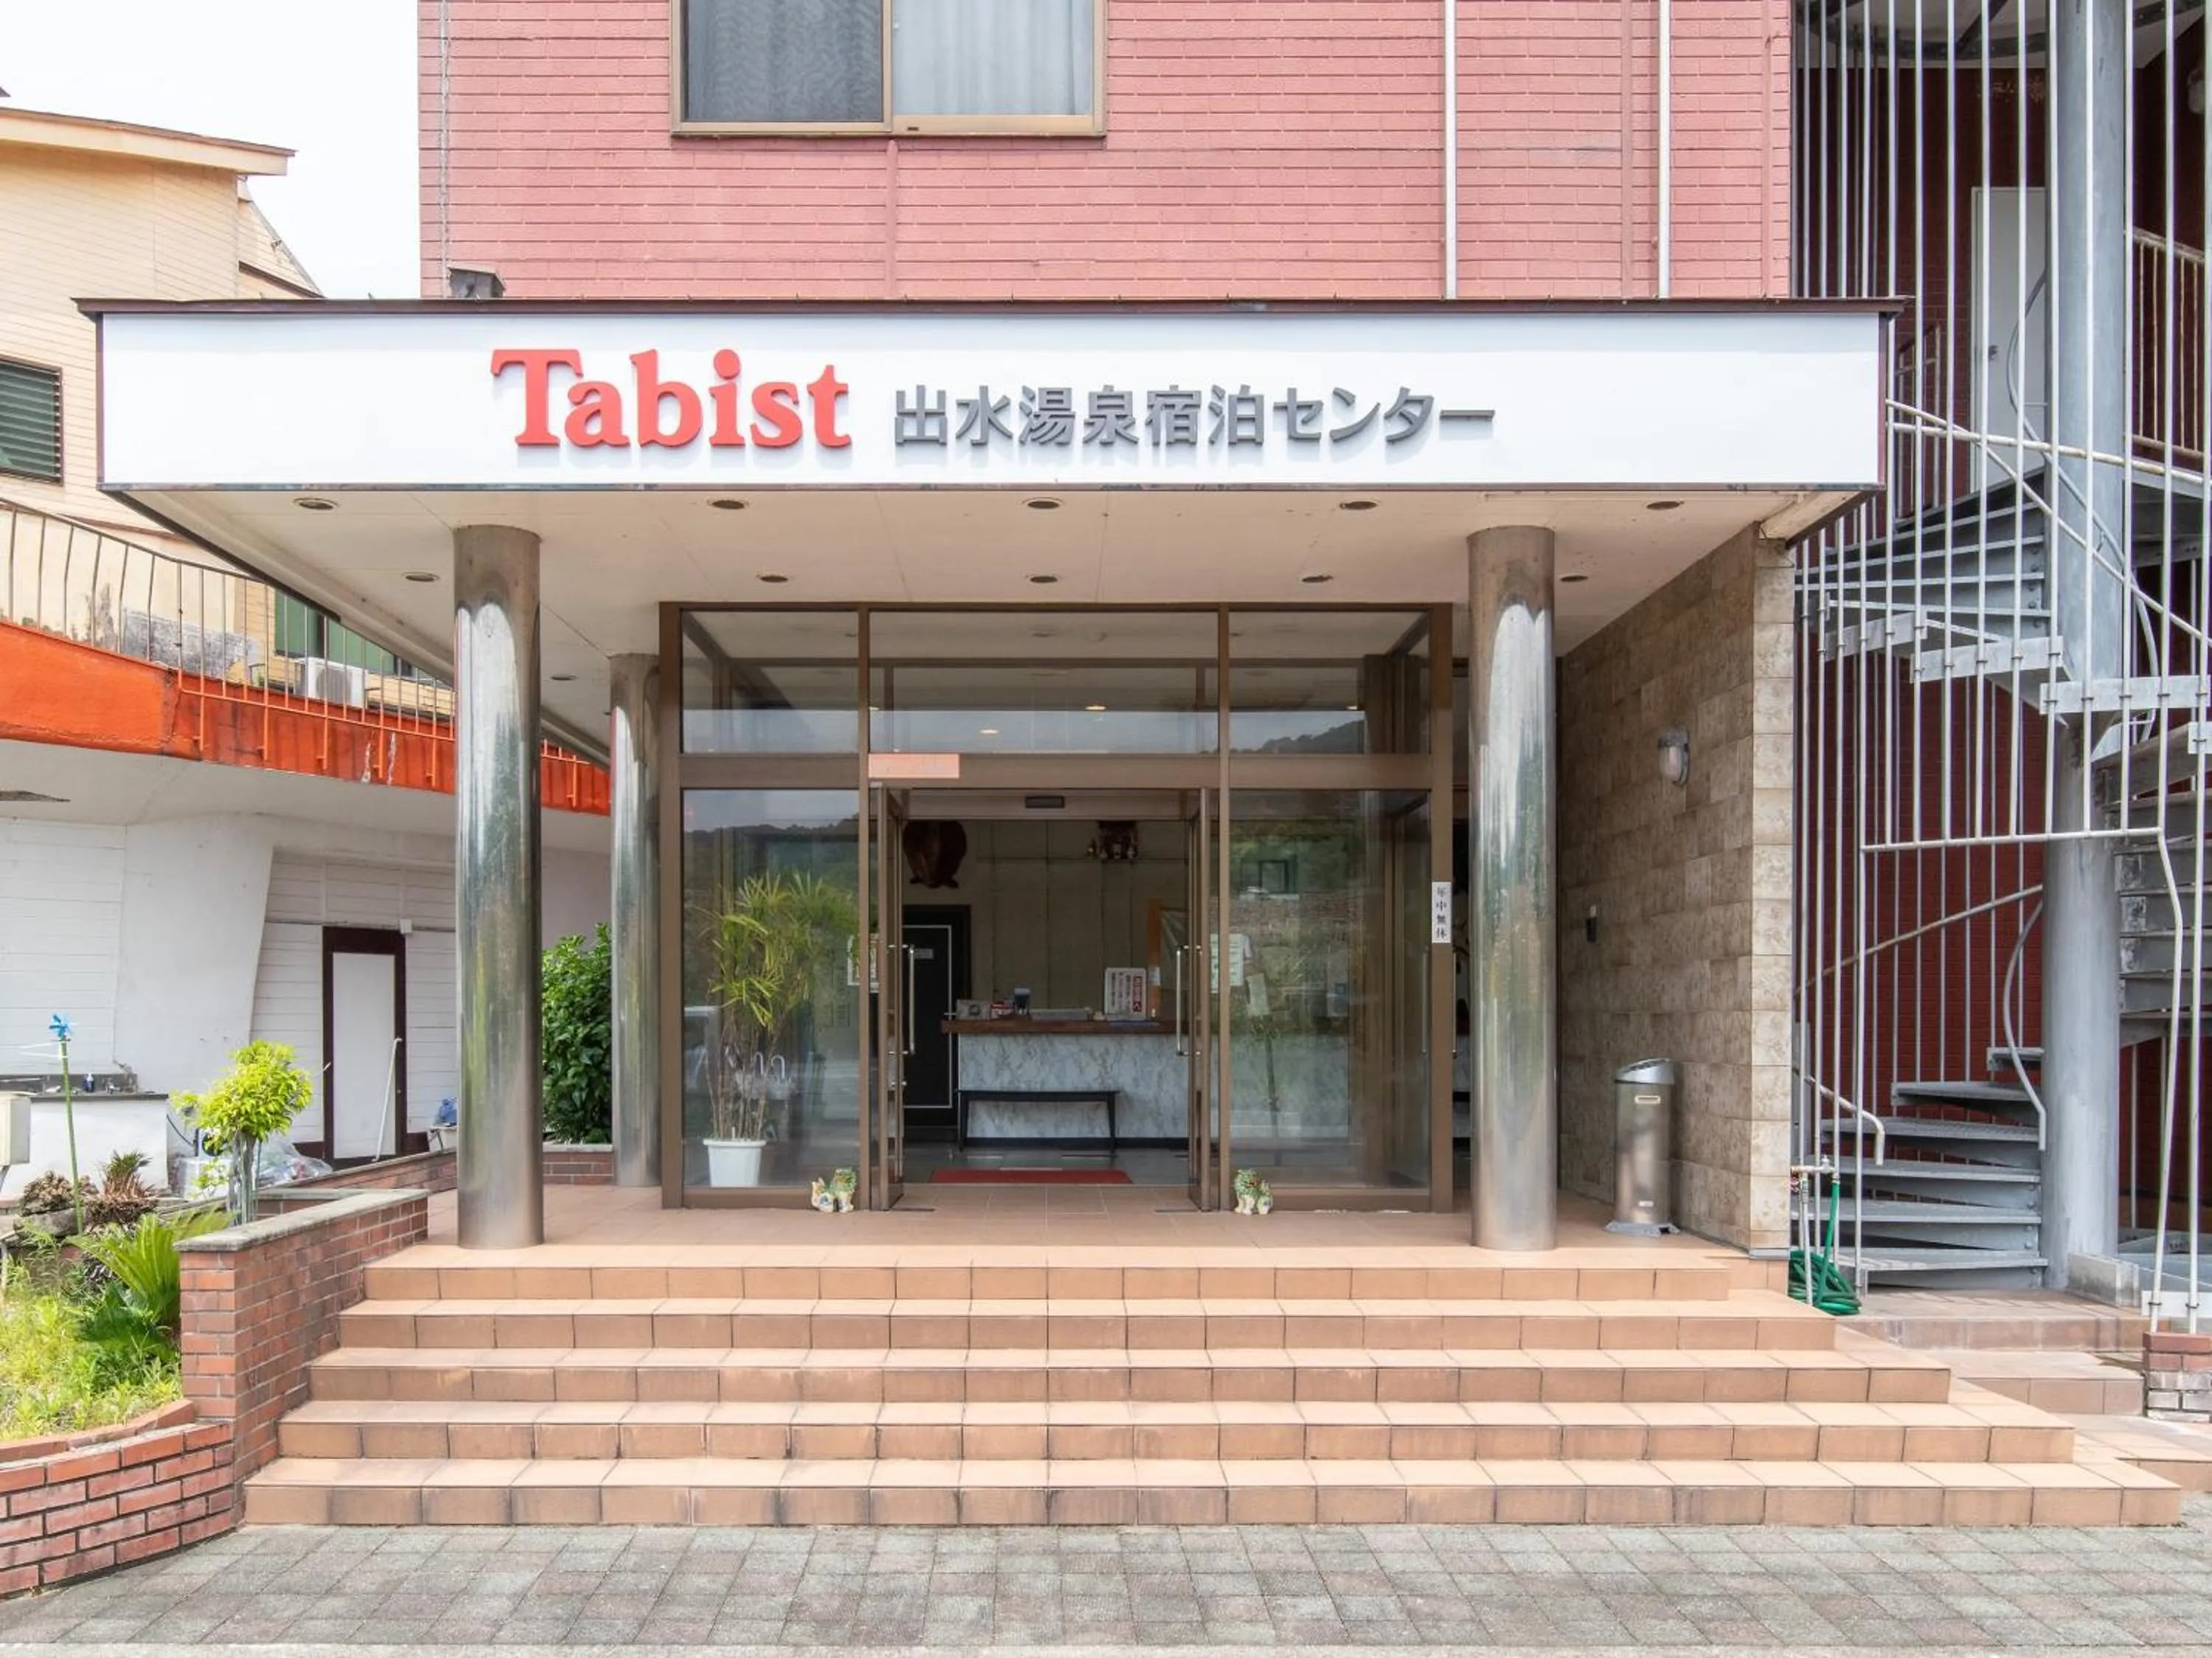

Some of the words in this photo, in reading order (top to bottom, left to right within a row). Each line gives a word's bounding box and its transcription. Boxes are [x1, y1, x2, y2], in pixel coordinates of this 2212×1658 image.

[492, 350, 851, 449] Tabist
[894, 386, 1495, 448] 出水湯泉宿泊センター
[1436, 887, 1447, 939] 年中無休
